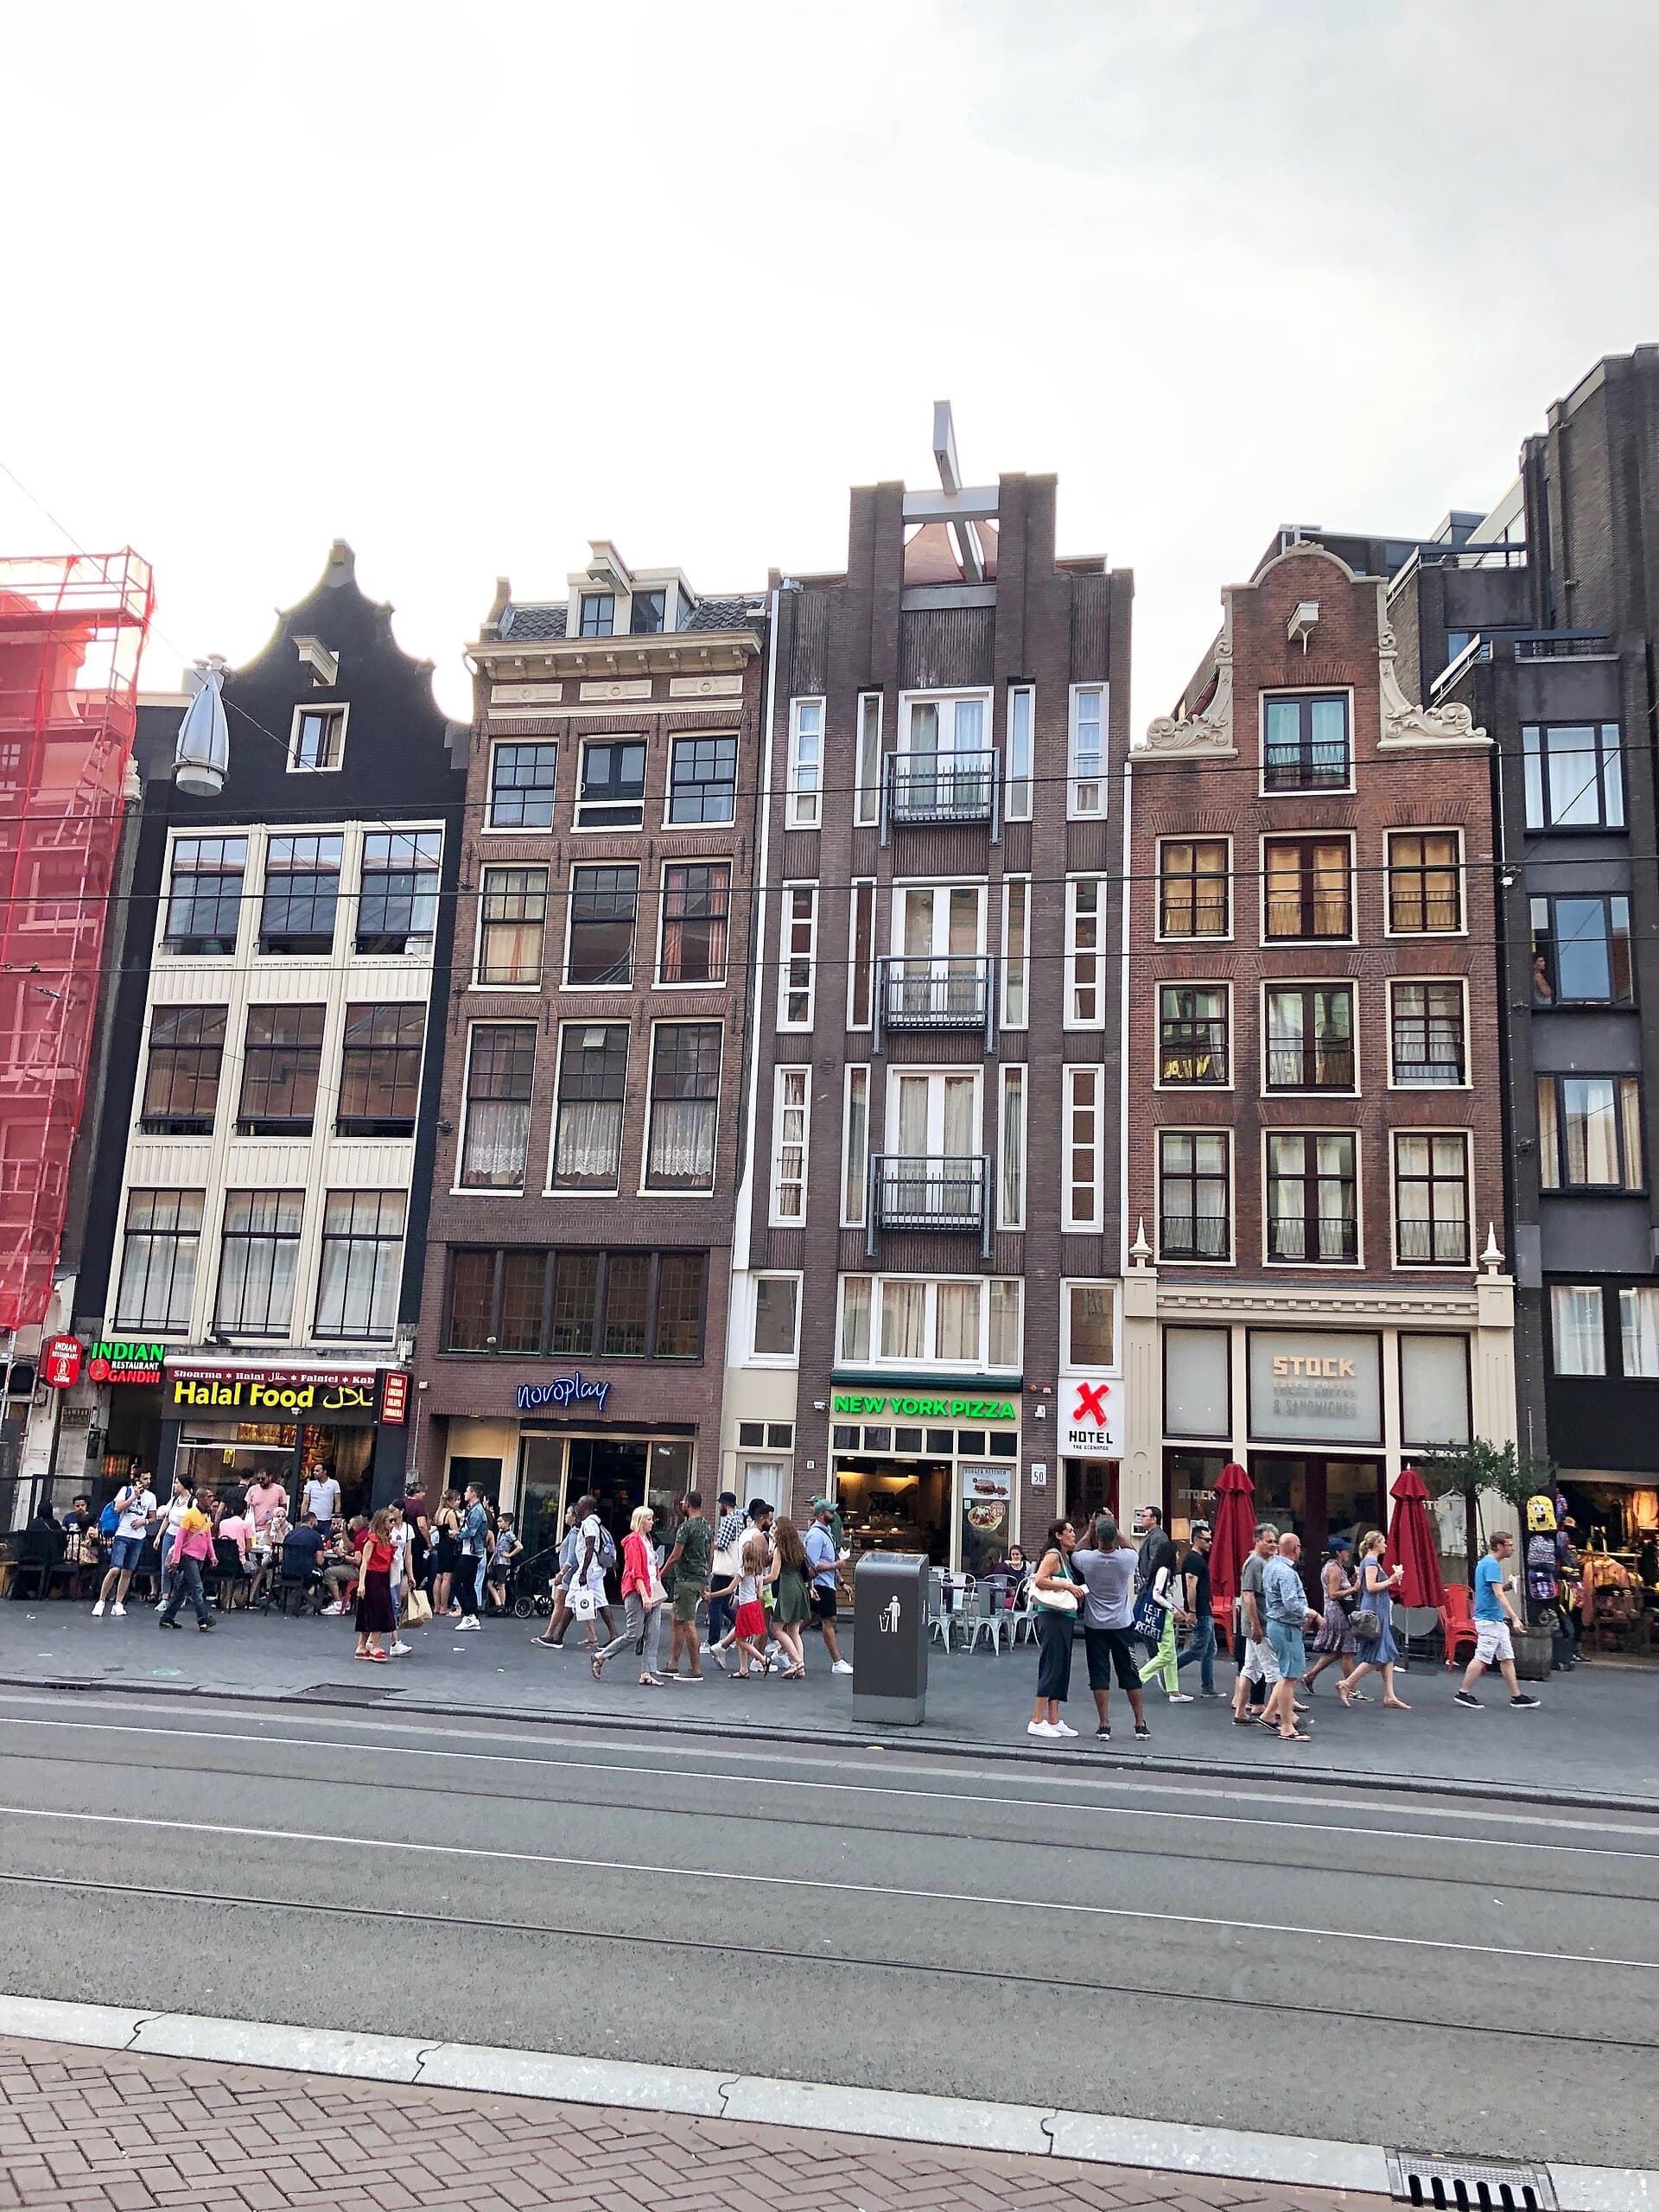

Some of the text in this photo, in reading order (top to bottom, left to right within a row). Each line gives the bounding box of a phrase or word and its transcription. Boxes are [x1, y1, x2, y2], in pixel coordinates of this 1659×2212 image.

[54, 1342, 78, 1352] INDIAN
[92, 1342, 164, 1361] INDIAN
[111, 1361, 159, 1370] RESTAURANT
[1273, 1356, 1356, 1376] STOCK
[108, 1370, 161, 1383] GANDHI
[174, 1370, 222, 1379] Shoarma
[174, 1381, 315, 1408] Halal Food
[834, 1395, 1016, 1421] NEW YORK PIZZA
[1069, 1430, 1113, 1444] HOTEL
[1033, 1471, 1044, 1483] 50
[1145, 1613, 1156, 1627] WE
